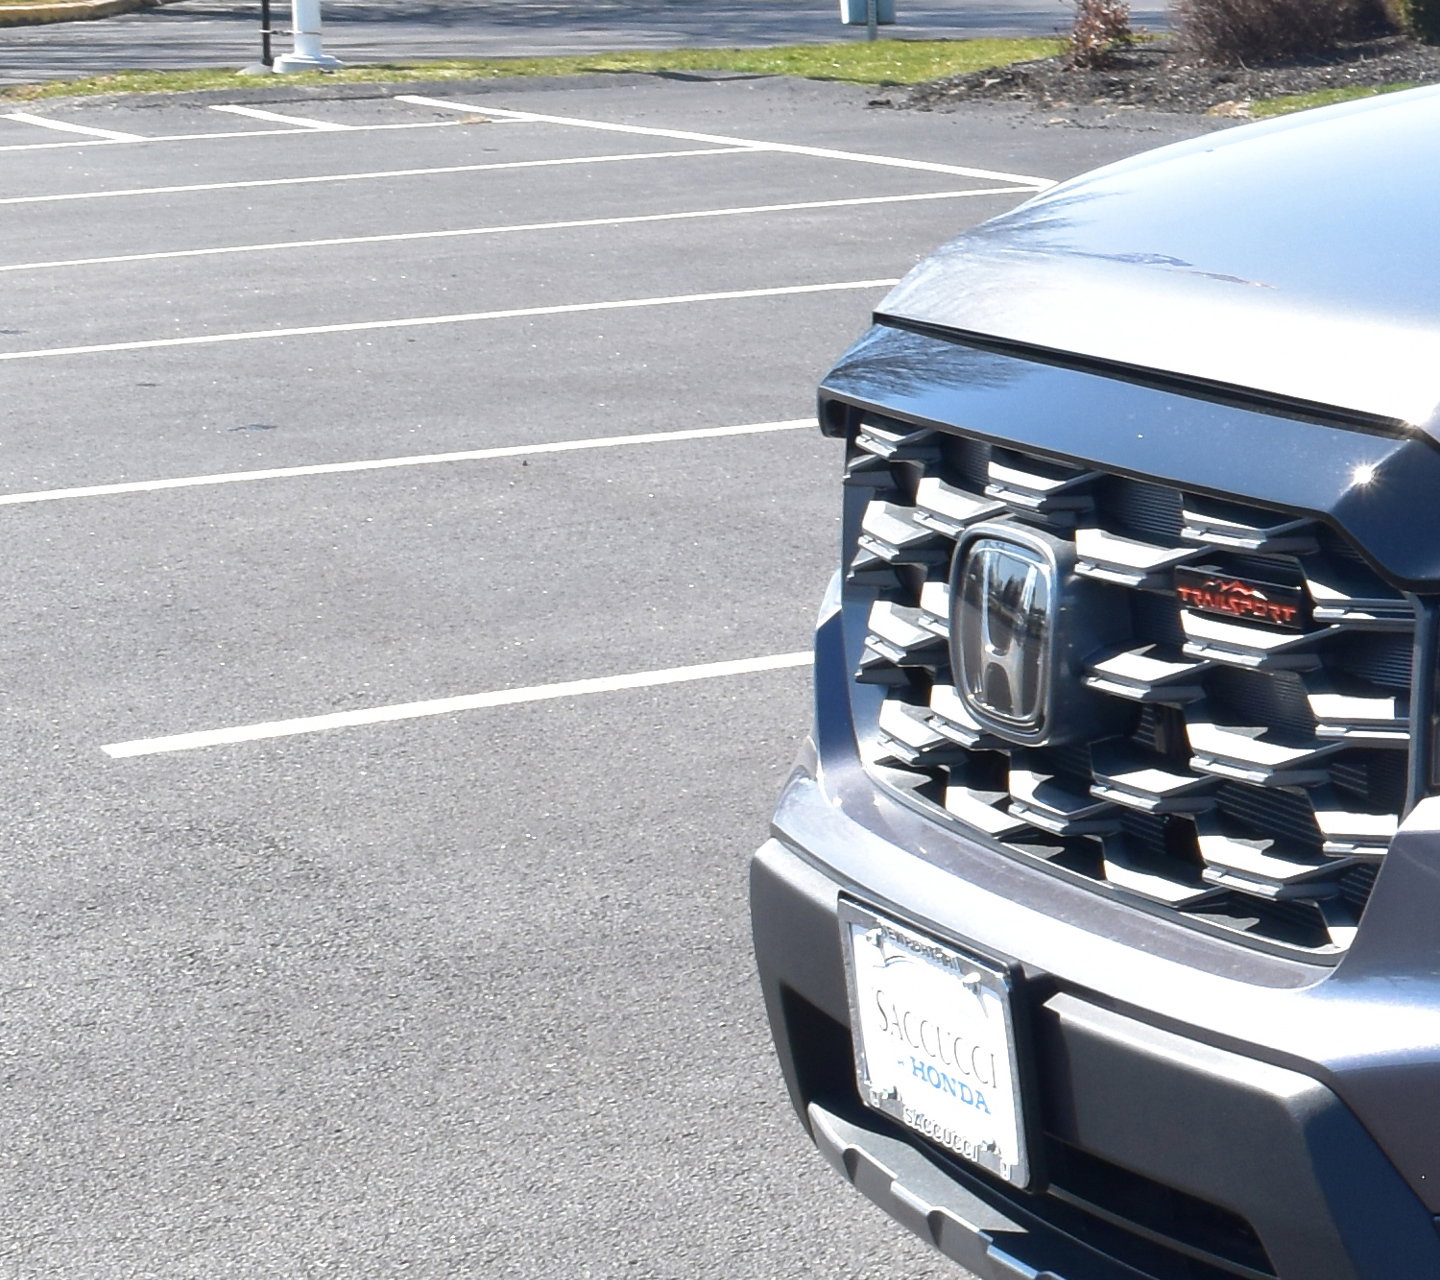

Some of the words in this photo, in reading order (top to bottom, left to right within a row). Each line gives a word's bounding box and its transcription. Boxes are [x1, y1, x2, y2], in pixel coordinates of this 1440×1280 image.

[1177, 585, 1297, 624] TRAILSPORT
[875, 989, 997, 1089] SACCUCCI
[909, 1055, 992, 1115] HONDA
